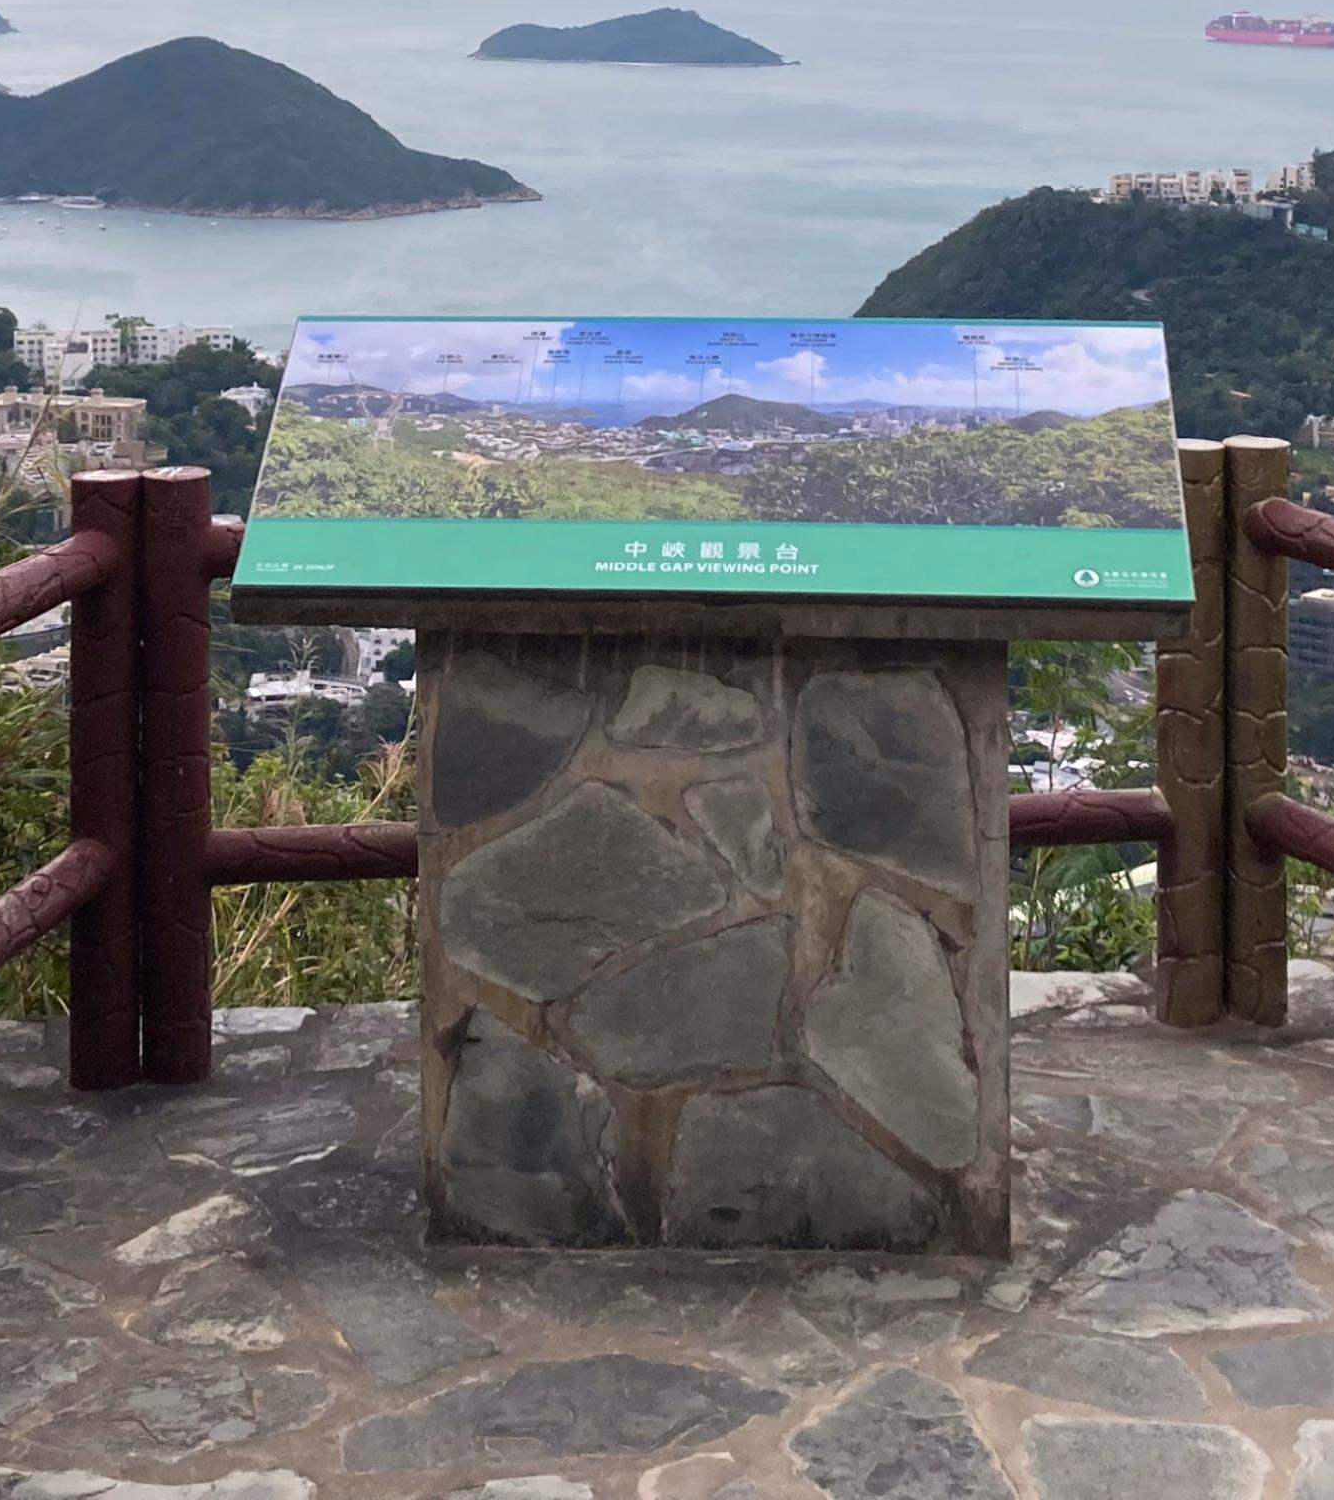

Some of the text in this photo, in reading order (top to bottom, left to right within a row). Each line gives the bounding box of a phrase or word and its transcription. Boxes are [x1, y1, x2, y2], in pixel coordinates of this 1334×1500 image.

[624, 541, 799, 561] 中峽觀景台
[595, 562, 820, 575] MIDDLE GAP VIEWING POINT
